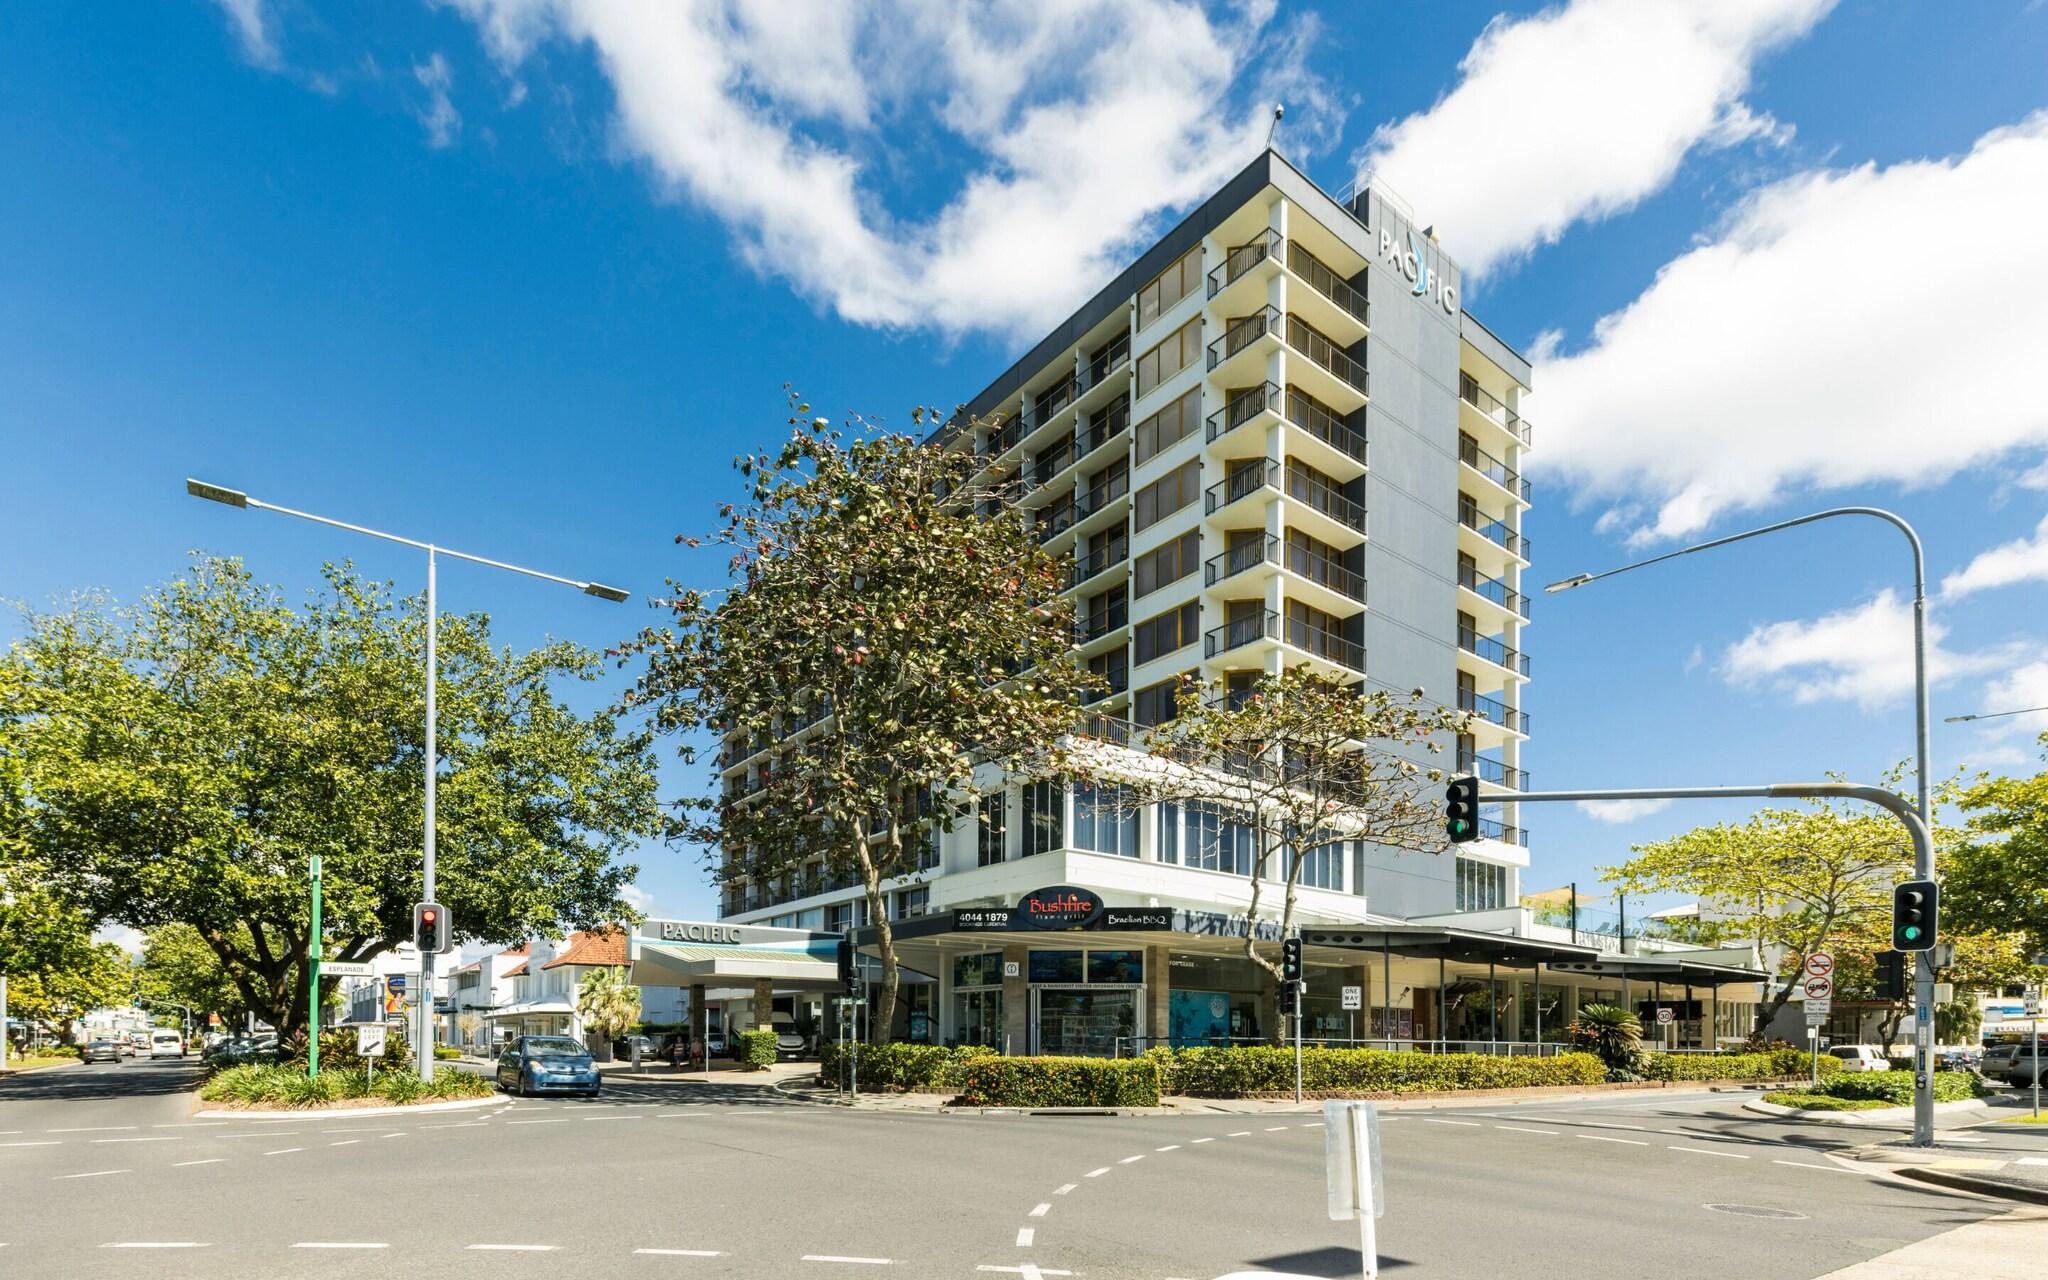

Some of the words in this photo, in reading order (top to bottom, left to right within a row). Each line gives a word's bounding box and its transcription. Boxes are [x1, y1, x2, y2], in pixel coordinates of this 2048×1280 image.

[1379, 227, 1456, 314] PACIFIC
[1029, 893, 1092, 913] Bushfire
[959, 913, 983, 922] 4044
[985, 912, 1008, 922] 1879
[1108, 914, 1142, 925] Brazilian
[1143, 914, 1167, 925] BBQ
[662, 922, 741, 944] PACIFIC
[328, 965, 365, 973] ESPLANADE
[2025, 992, 2037, 1000] ONE
